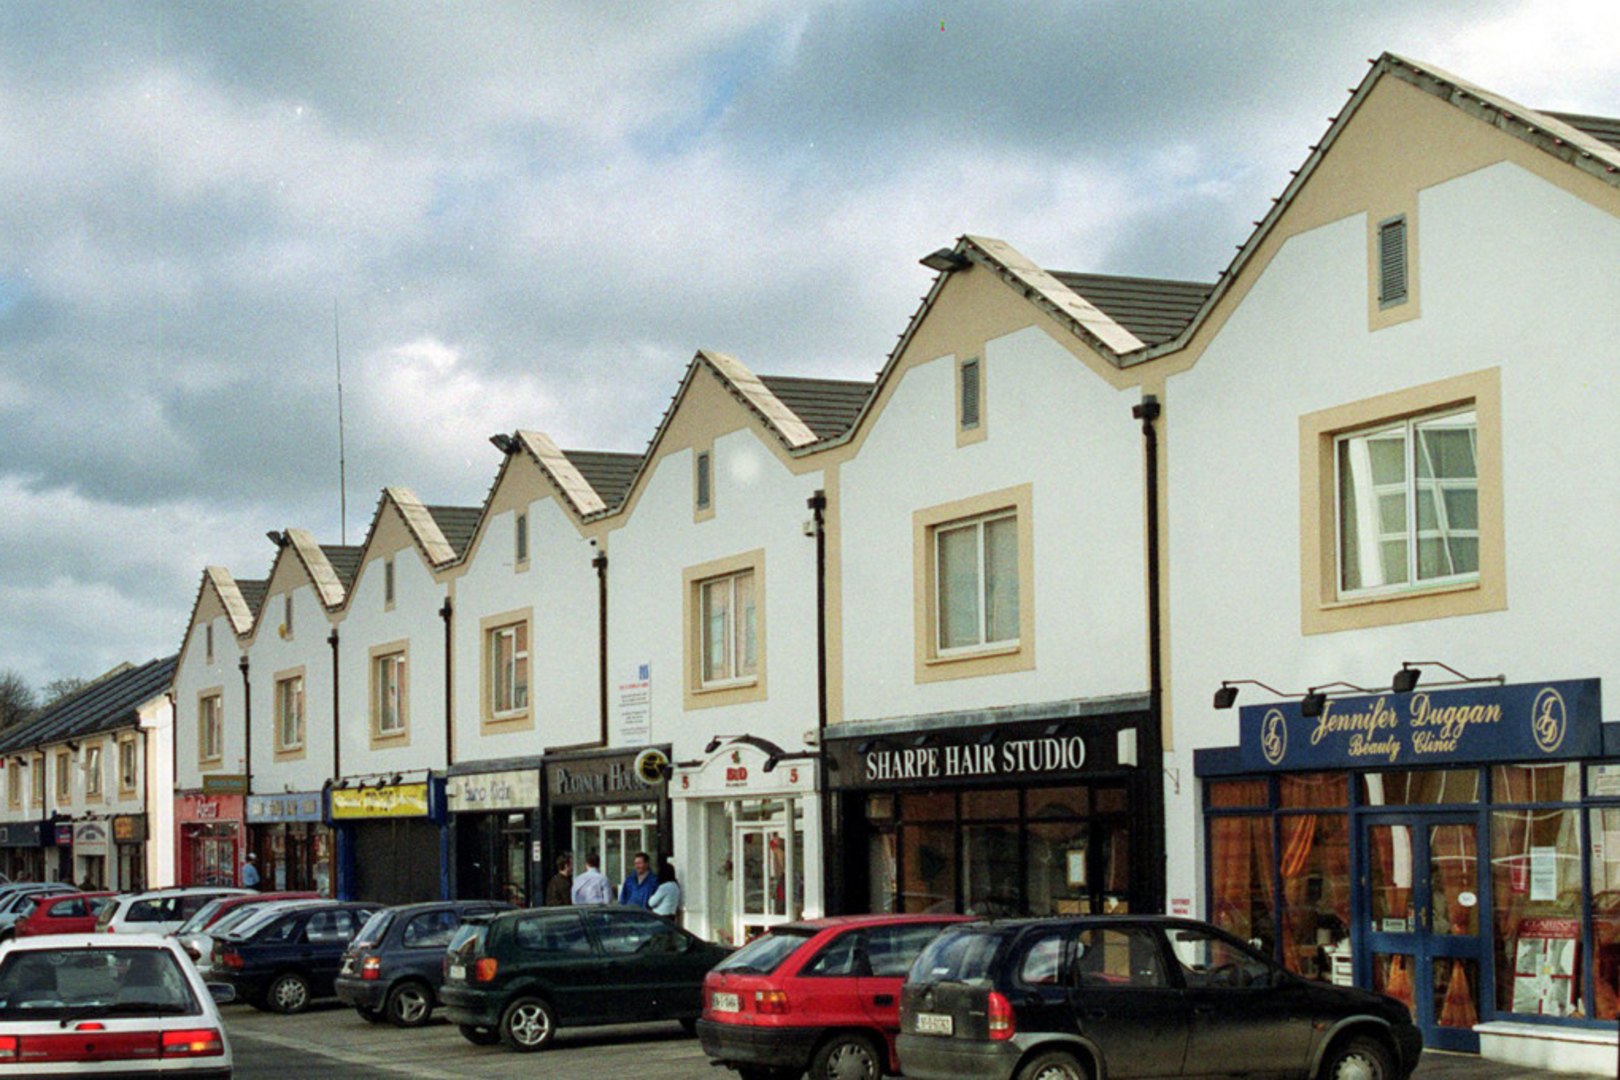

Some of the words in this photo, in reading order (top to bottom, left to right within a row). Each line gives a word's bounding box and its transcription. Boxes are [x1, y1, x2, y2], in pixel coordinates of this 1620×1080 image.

[1310, 697, 1397, 745] Jennifer
[1409, 692, 1503, 739] Duggan
[865, 746, 941, 781] SHARPE
[944, 743, 998, 777] HAIR
[1002, 735, 1087, 773] STUDIO
[1347, 733, 1401, 763] Beauty
[1411, 729, 1458, 755] Clinic
[682, 775, 690, 790] 5
[789, 767, 799, 784] 5
